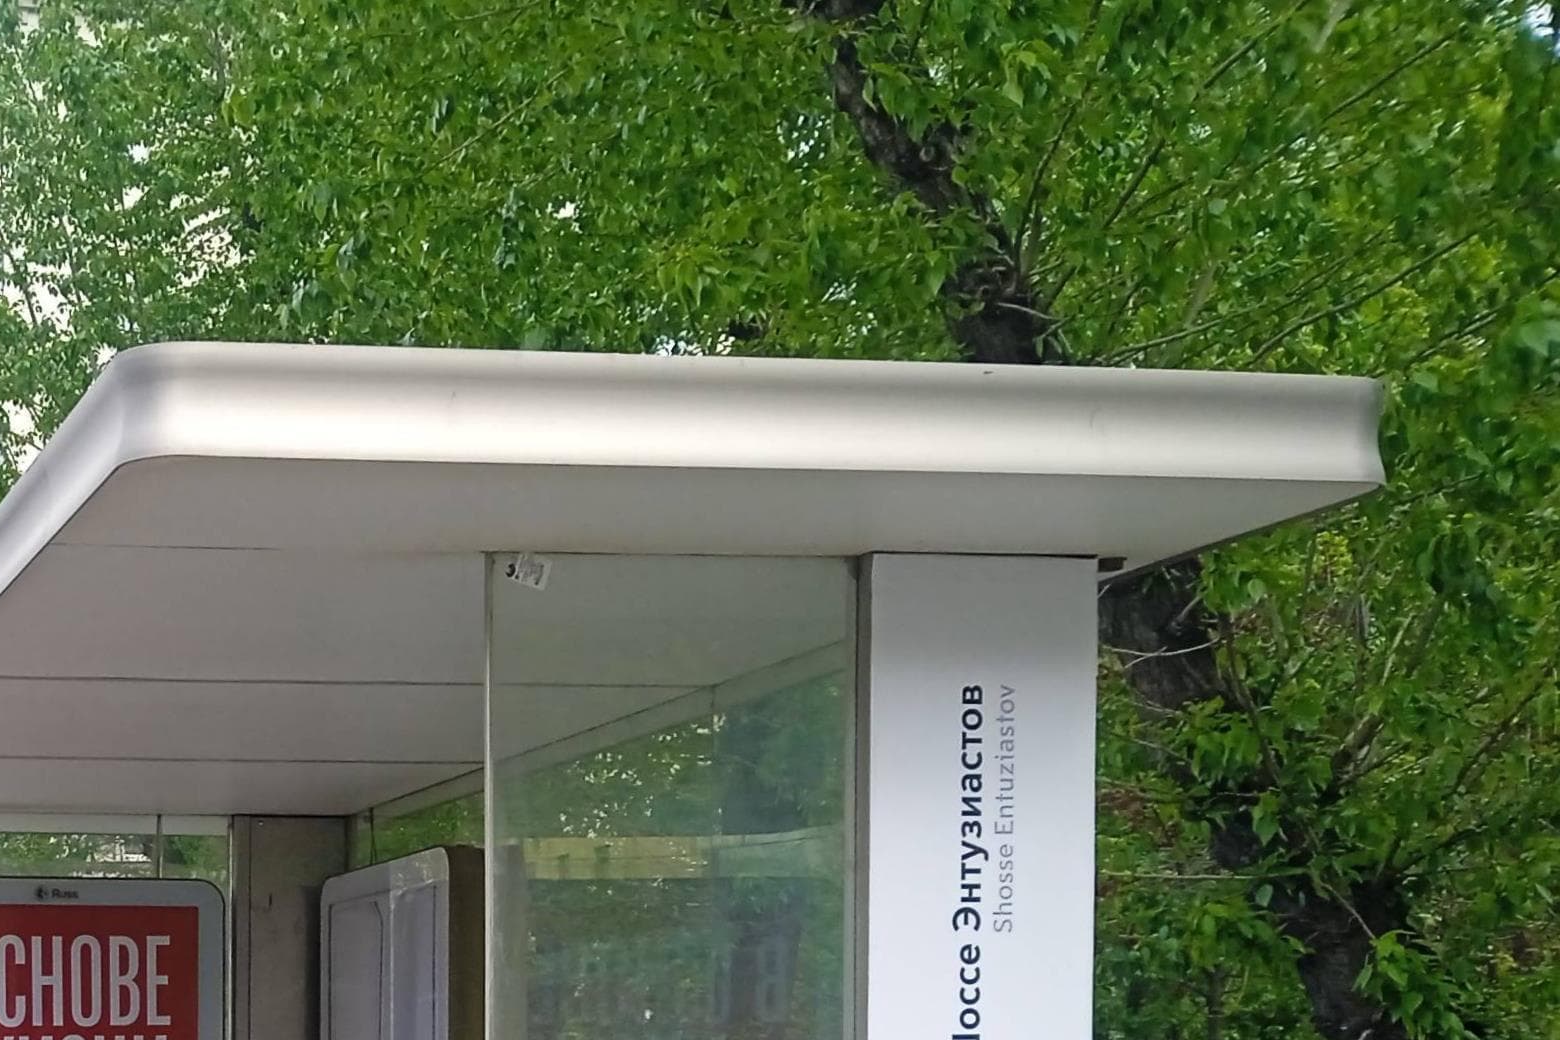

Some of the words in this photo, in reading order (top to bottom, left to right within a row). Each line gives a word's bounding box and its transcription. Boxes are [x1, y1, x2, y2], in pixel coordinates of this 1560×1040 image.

[951, 684, 989, 932] Энтузиастов
[994, 684, 1016, 835] Entuziastov
[993, 843, 1014, 933] Shosse
